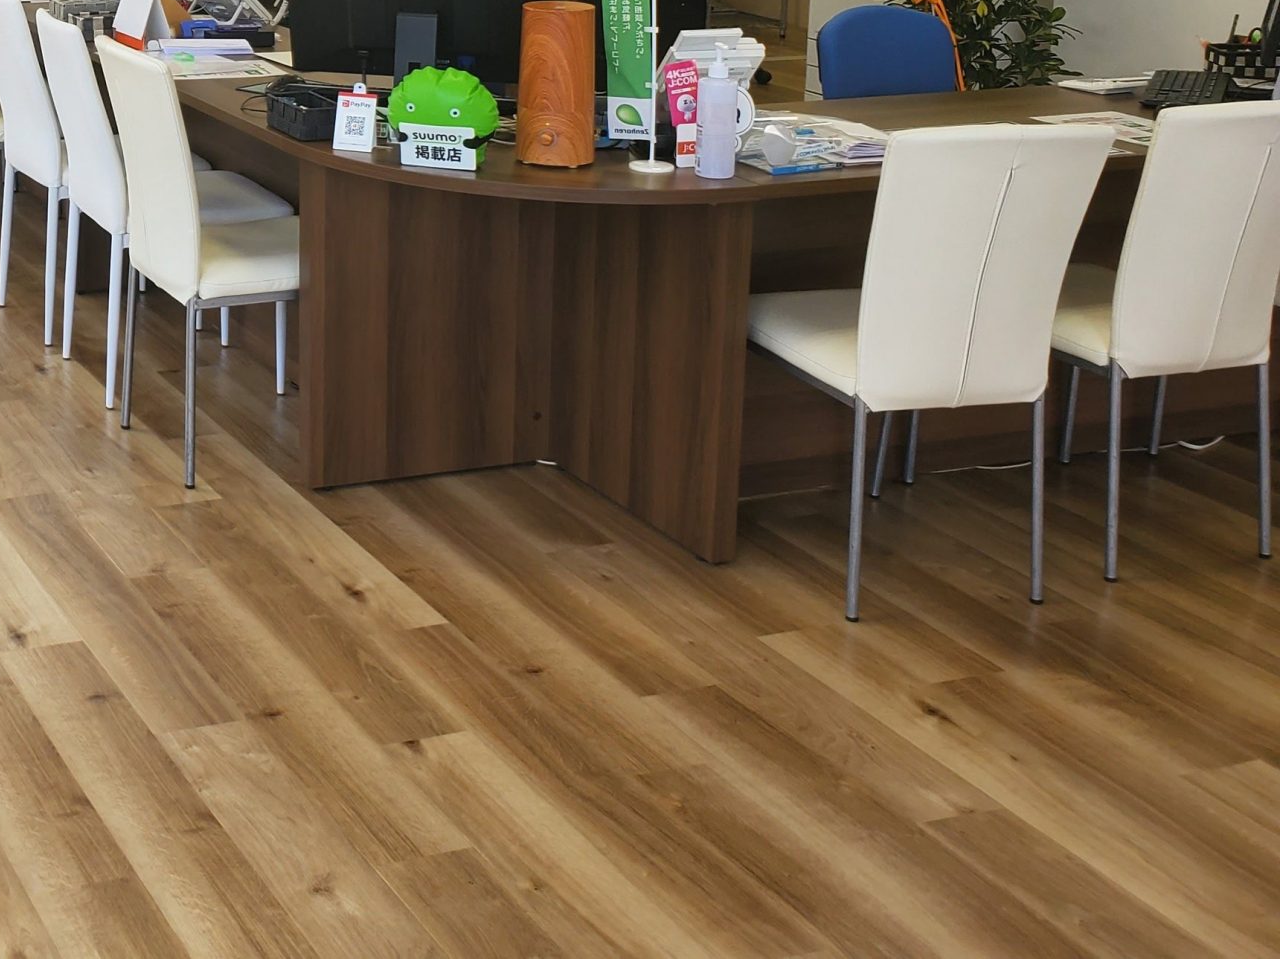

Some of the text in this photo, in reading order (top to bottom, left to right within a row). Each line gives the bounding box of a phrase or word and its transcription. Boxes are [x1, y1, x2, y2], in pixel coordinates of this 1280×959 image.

[666, 70, 680, 80] 4K
[350, 101, 371, 109] PayPay
[683, 143, 696, 153] J:C
[415, 145, 462, 162] 掲載店
